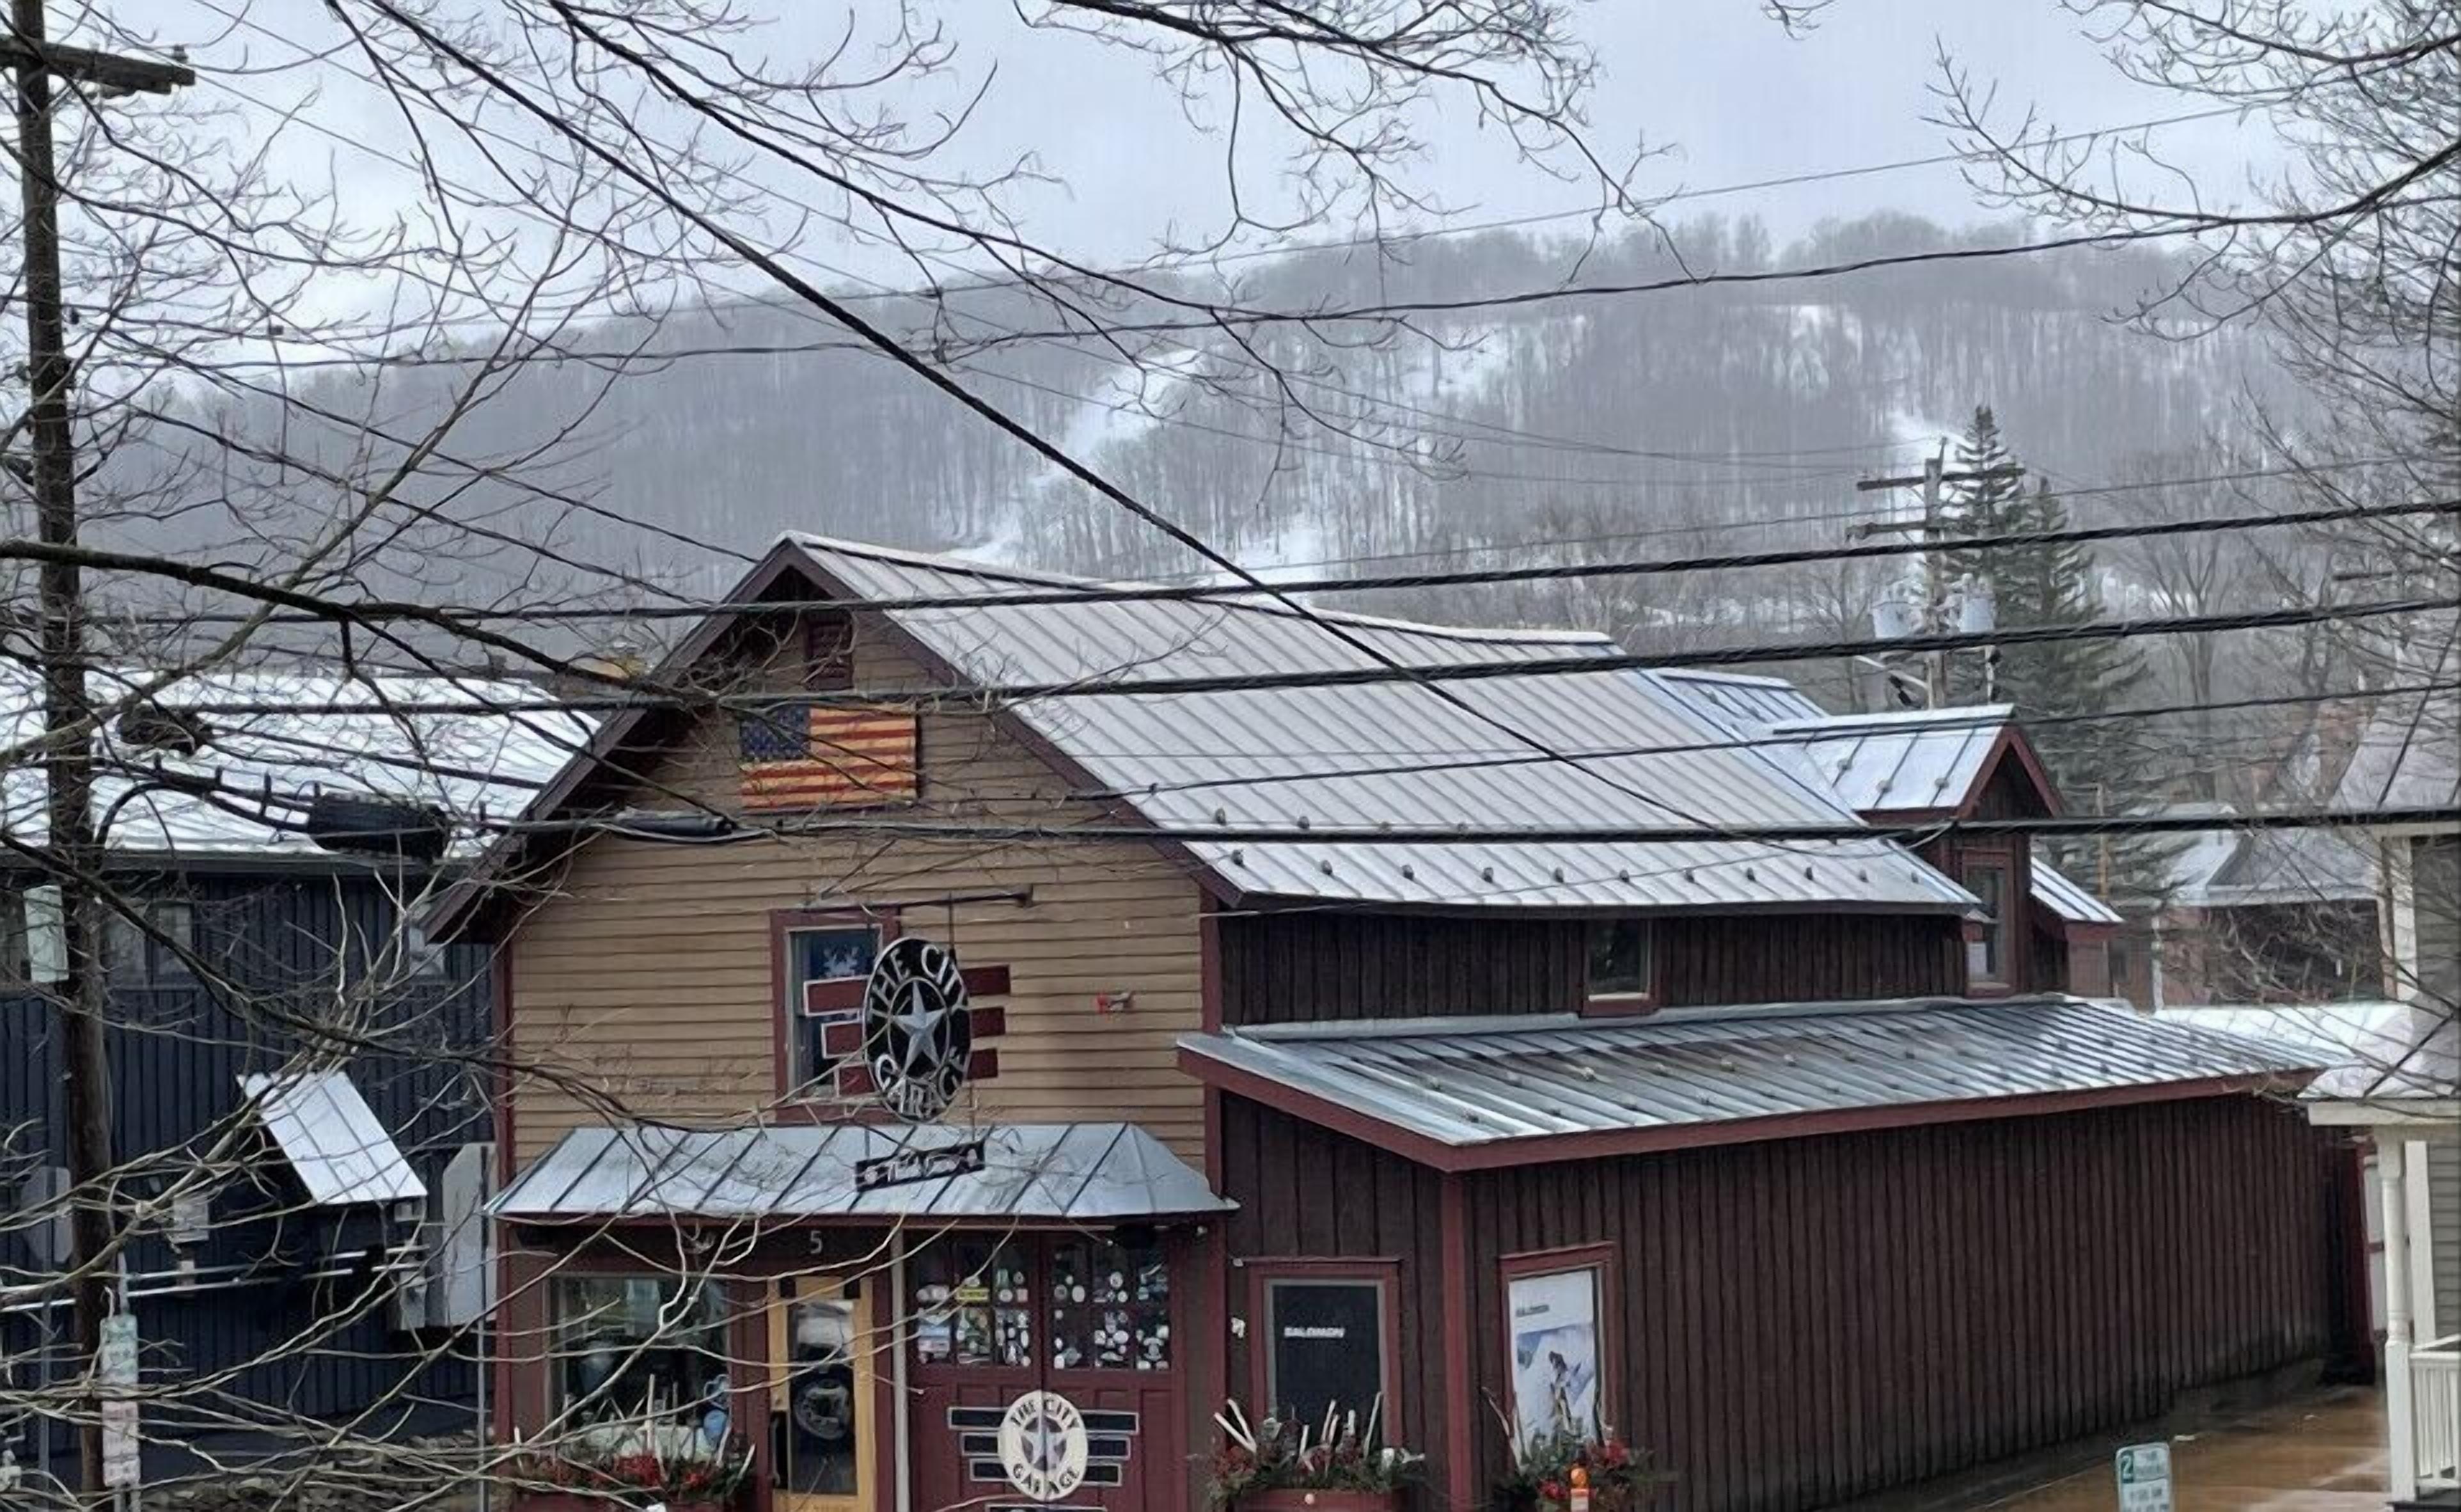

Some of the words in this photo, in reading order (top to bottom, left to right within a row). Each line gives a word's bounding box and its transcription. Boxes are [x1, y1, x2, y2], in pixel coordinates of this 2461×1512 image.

[867, 948, 910, 1023] THE
[921, 944, 970, 1016] CITY
[810, 1230, 823, 1254] 5
[1009, 1399, 1036, 1427] THE
[1042, 1398, 1080, 1429] CITY
[1013, 1463, 1080, 1495] GARAGE
